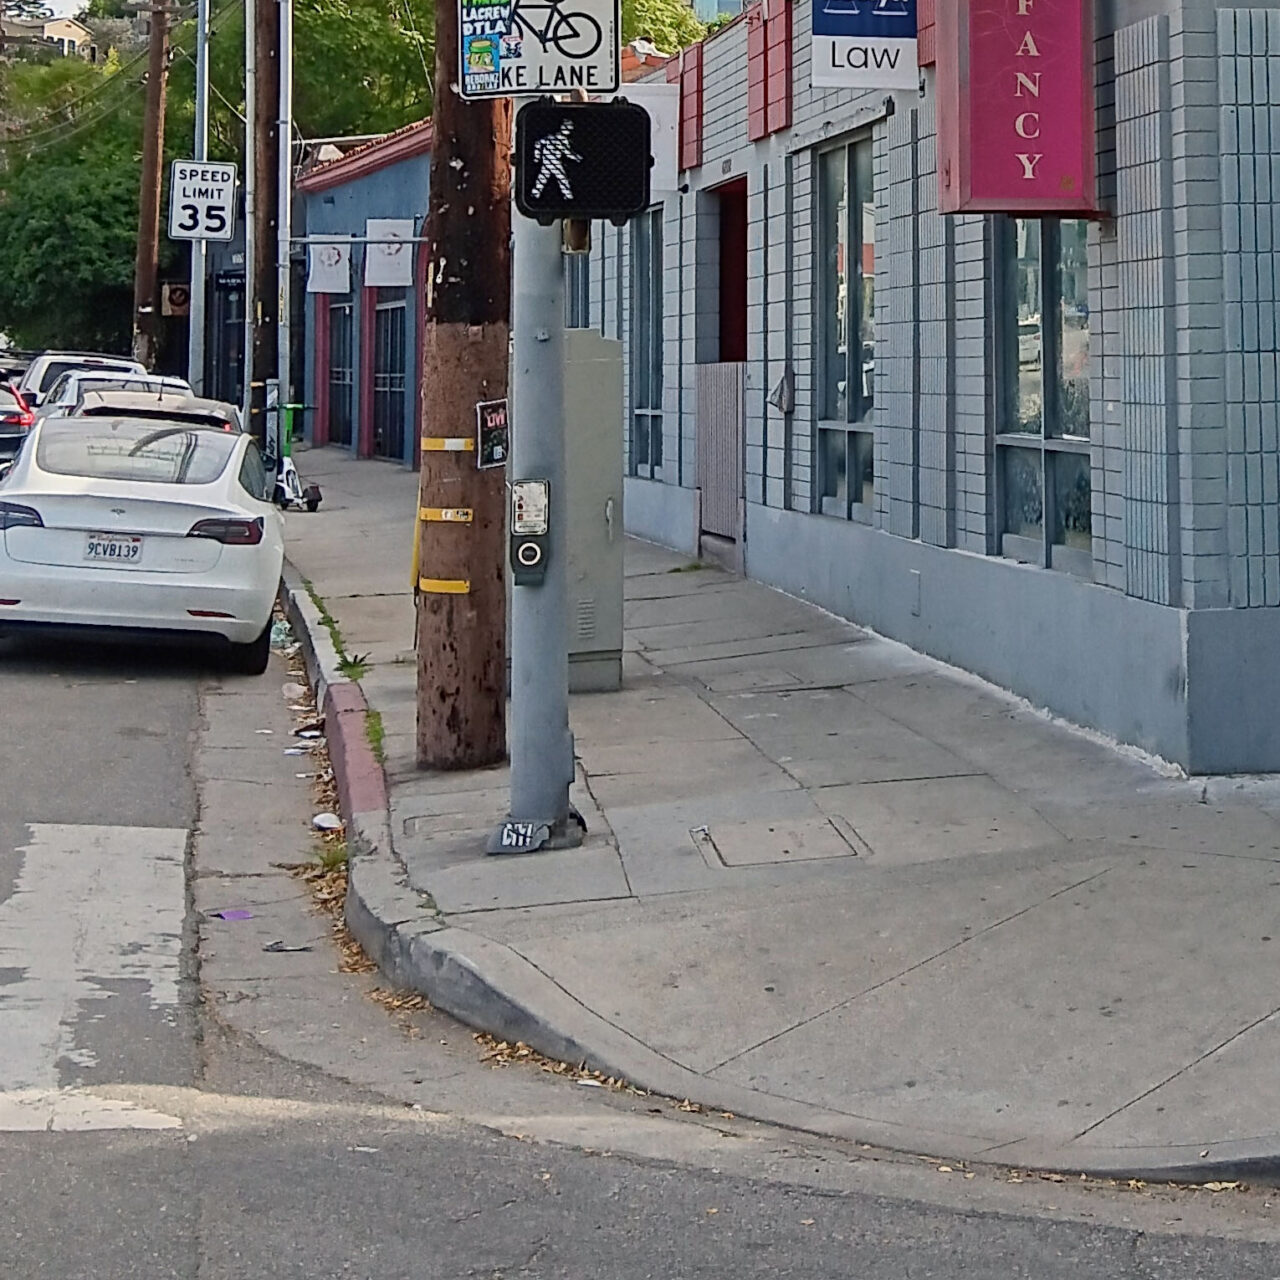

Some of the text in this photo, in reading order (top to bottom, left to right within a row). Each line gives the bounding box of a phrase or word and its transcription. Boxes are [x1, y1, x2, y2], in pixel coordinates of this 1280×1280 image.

[463, 20, 507, 37] DTLA
[831, 41, 901, 69] Law
[501, 65, 598, 87] KE LANE
[179, 169, 231, 182] SPEED
[183, 186, 224, 200] LIMIT
[178, 204, 226, 233] 35
[87, 542, 139, 558] 9CVB139
